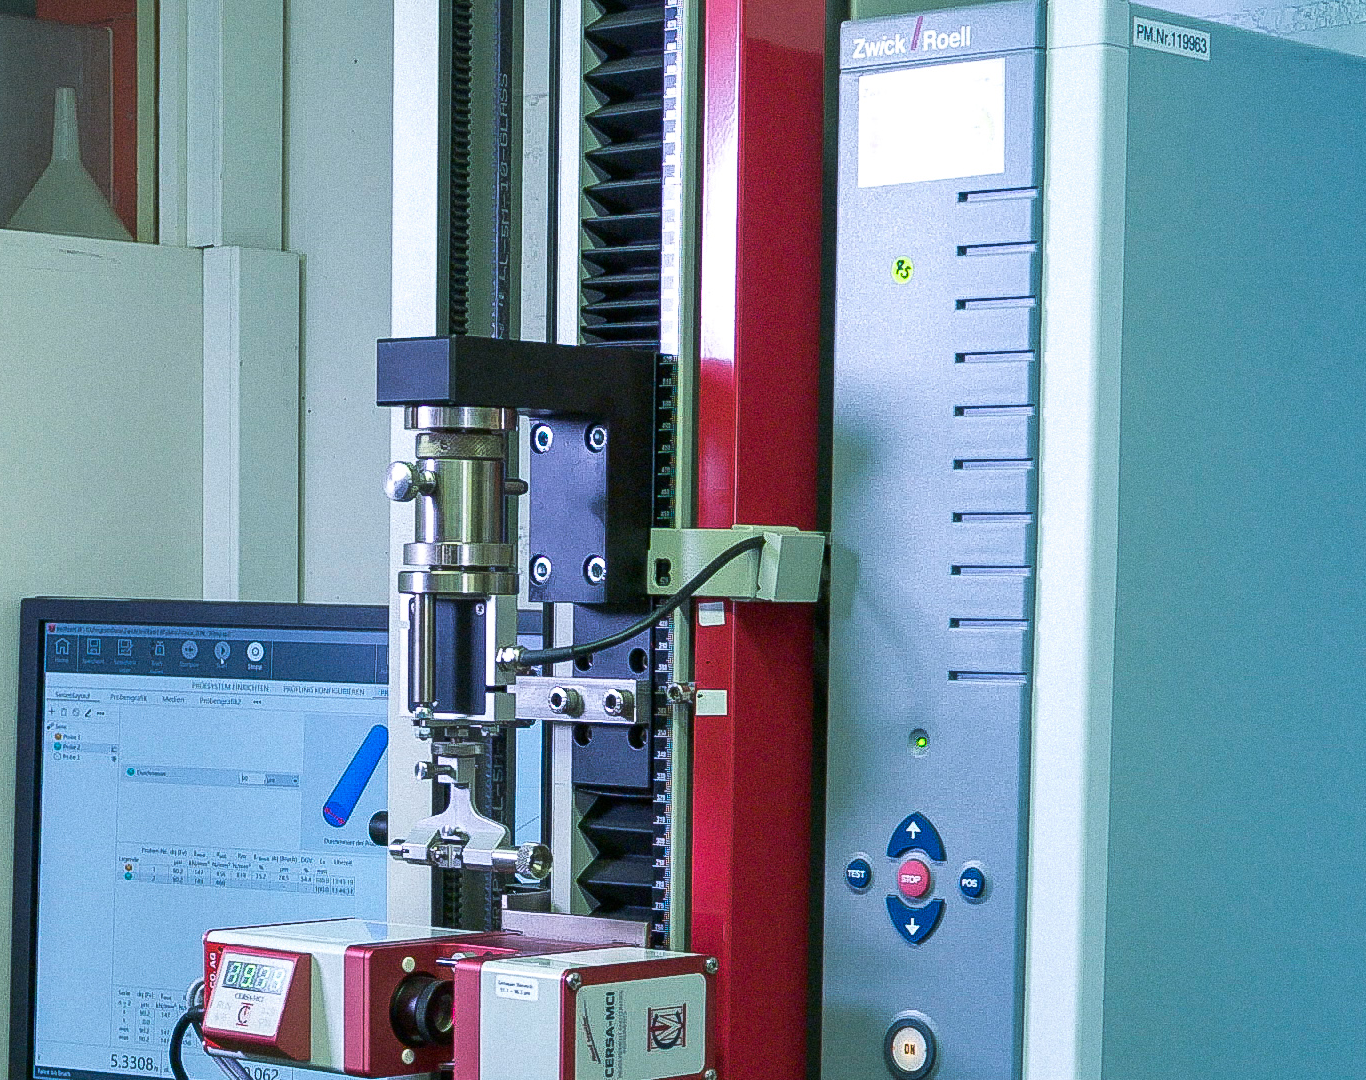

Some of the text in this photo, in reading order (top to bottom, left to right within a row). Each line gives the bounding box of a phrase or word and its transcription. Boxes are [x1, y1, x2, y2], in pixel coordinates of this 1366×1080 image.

[852, 26, 971, 58] Zwick Roell
[848, 869, 865, 879] TEST
[901, 874, 921, 884] STOP
[604, 991, 615, 1078] CERSA-MCI
[904, 1044, 916, 1055] ON
[110, 1054, 153, 1071] 5.3308
